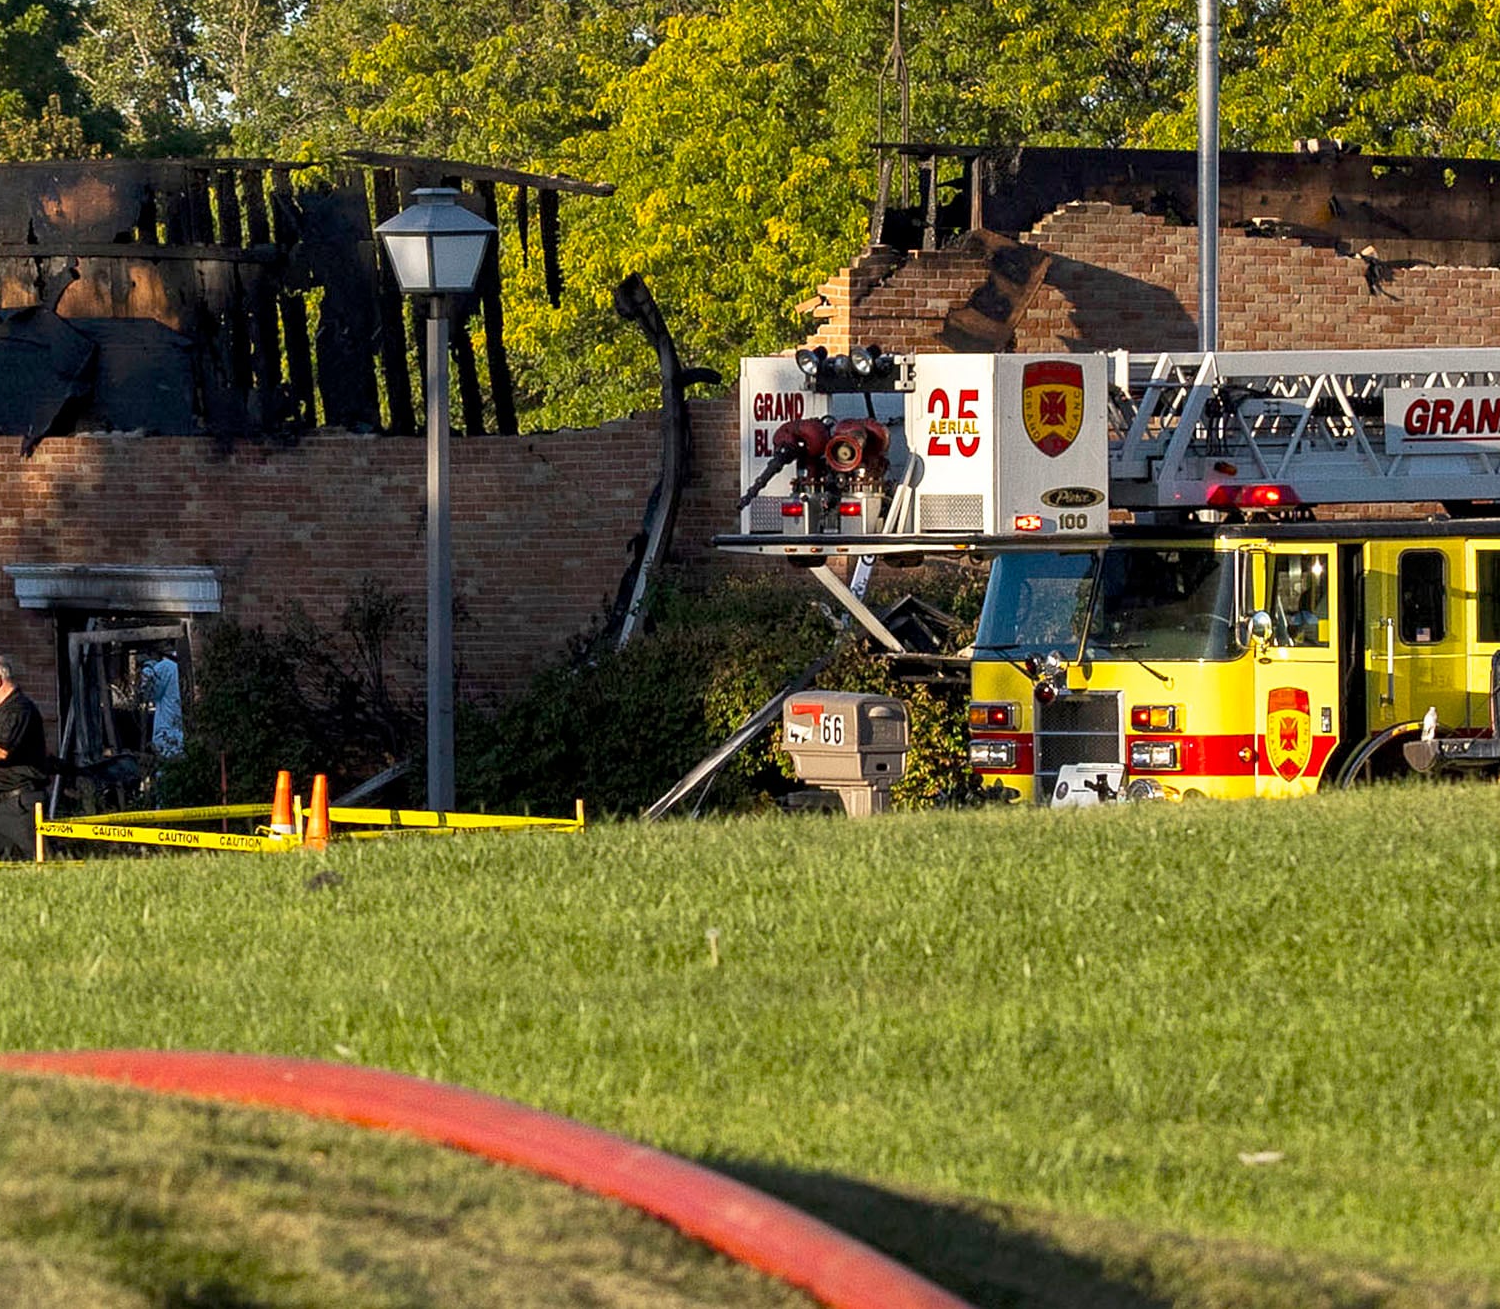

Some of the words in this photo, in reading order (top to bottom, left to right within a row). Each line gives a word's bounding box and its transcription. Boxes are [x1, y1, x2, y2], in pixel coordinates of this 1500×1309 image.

[753, 392, 805, 422] GRAND
[927, 387, 981, 458] 25
[928, 420, 980, 435] AERIAL
[1059, 513, 1088, 530] 100
[822, 715, 842, 745] 66
[91, 826, 134, 838] CAUTION
[158, 832, 200, 844] CAUTION
[219, 836, 262, 848] CAUTION
